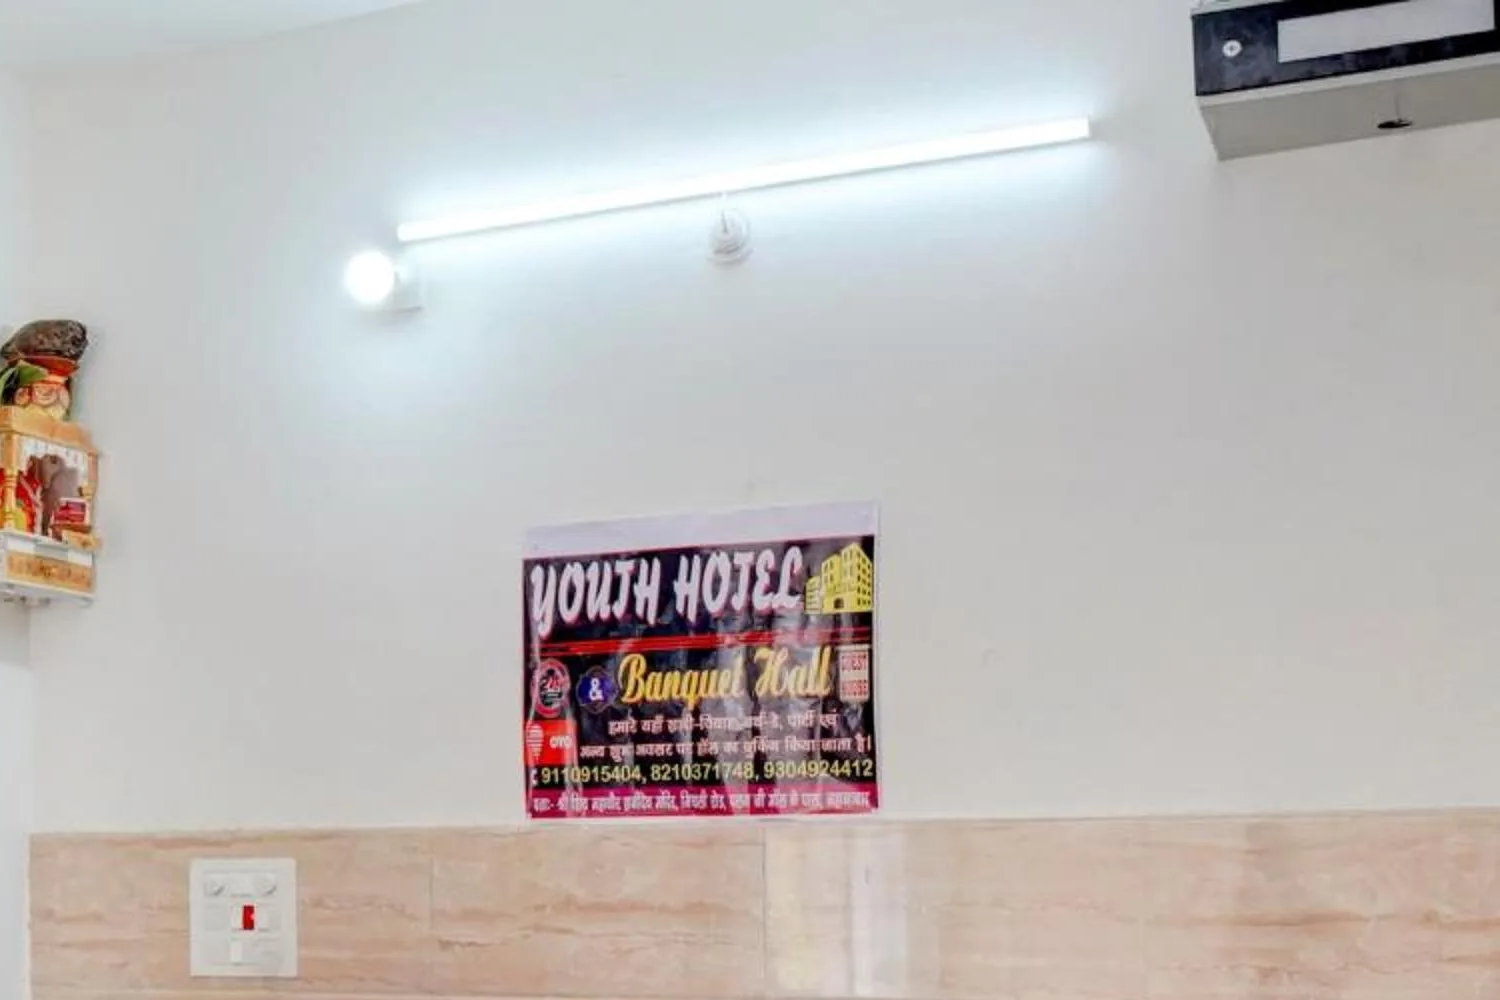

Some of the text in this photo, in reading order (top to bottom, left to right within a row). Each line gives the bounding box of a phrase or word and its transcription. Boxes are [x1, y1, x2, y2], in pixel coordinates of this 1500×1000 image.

[531, 546, 805, 640] YOUTH HOTEL
[589, 646, 834, 711] & Banquet Hall
[541, 763, 647, 785] 9110915404,
[764, 759, 873, 779] 9304924412
